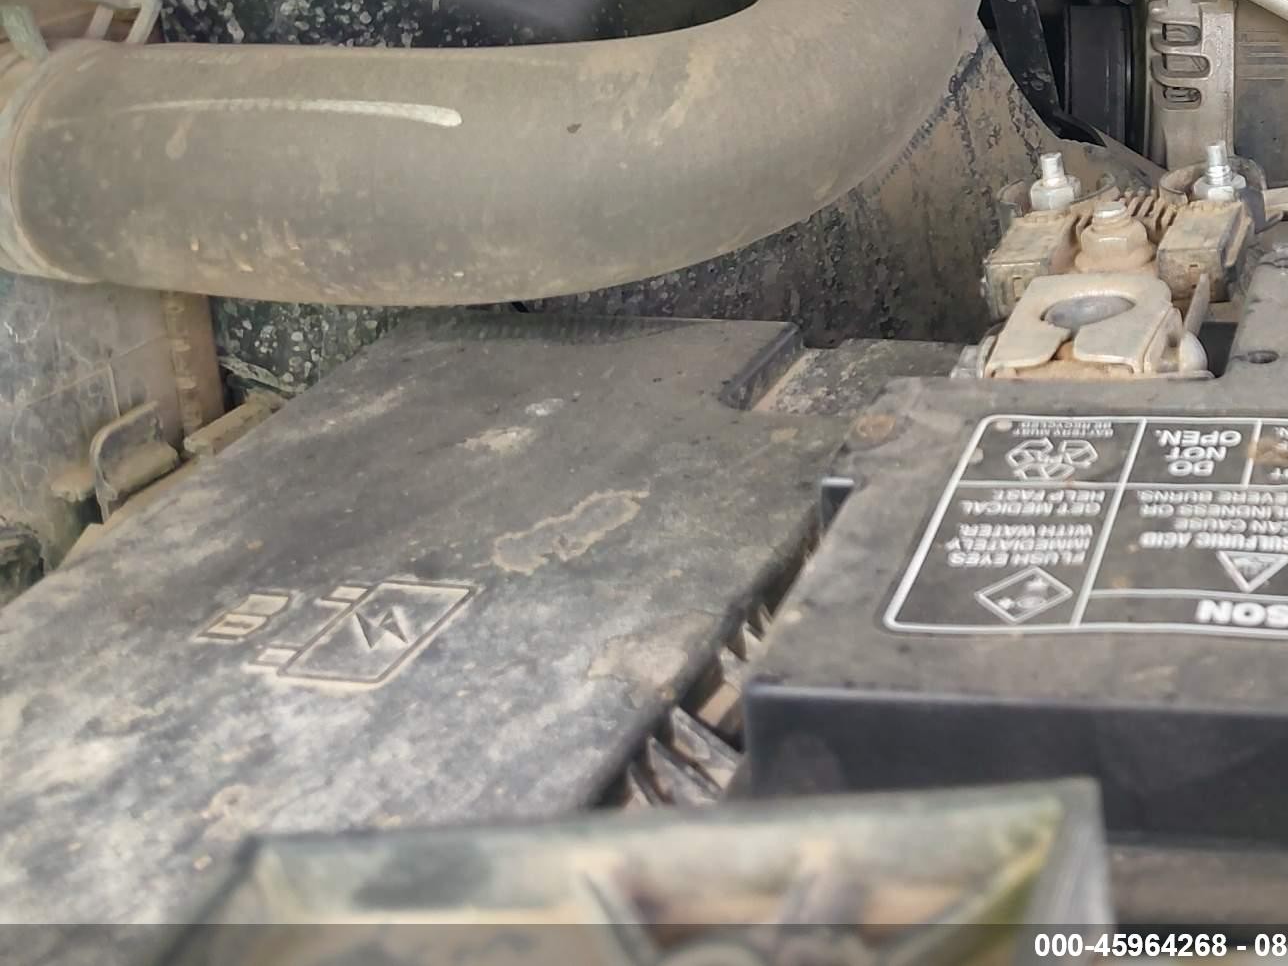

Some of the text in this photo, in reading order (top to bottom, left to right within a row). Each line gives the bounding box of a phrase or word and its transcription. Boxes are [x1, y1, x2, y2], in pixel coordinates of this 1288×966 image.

[1155, 427, 1242, 446] OPEN.
[1164, 444, 1227, 461] NOT
[1168, 458, 1214, 475] DO
[1048, 488, 1105, 503] HELP
[960, 498, 1100, 516] GET MEDICAL
[1139, 502, 1174, 517] OR
[1037, 522, 1093, 536] WITH
[1174, 516, 1247, 532] CAUSE
[944, 535, 1091, 550] IMMEDIATELY
[1139, 530, 1192, 548] ACID
[946, 549, 1086, 567] FLUSH EYES
